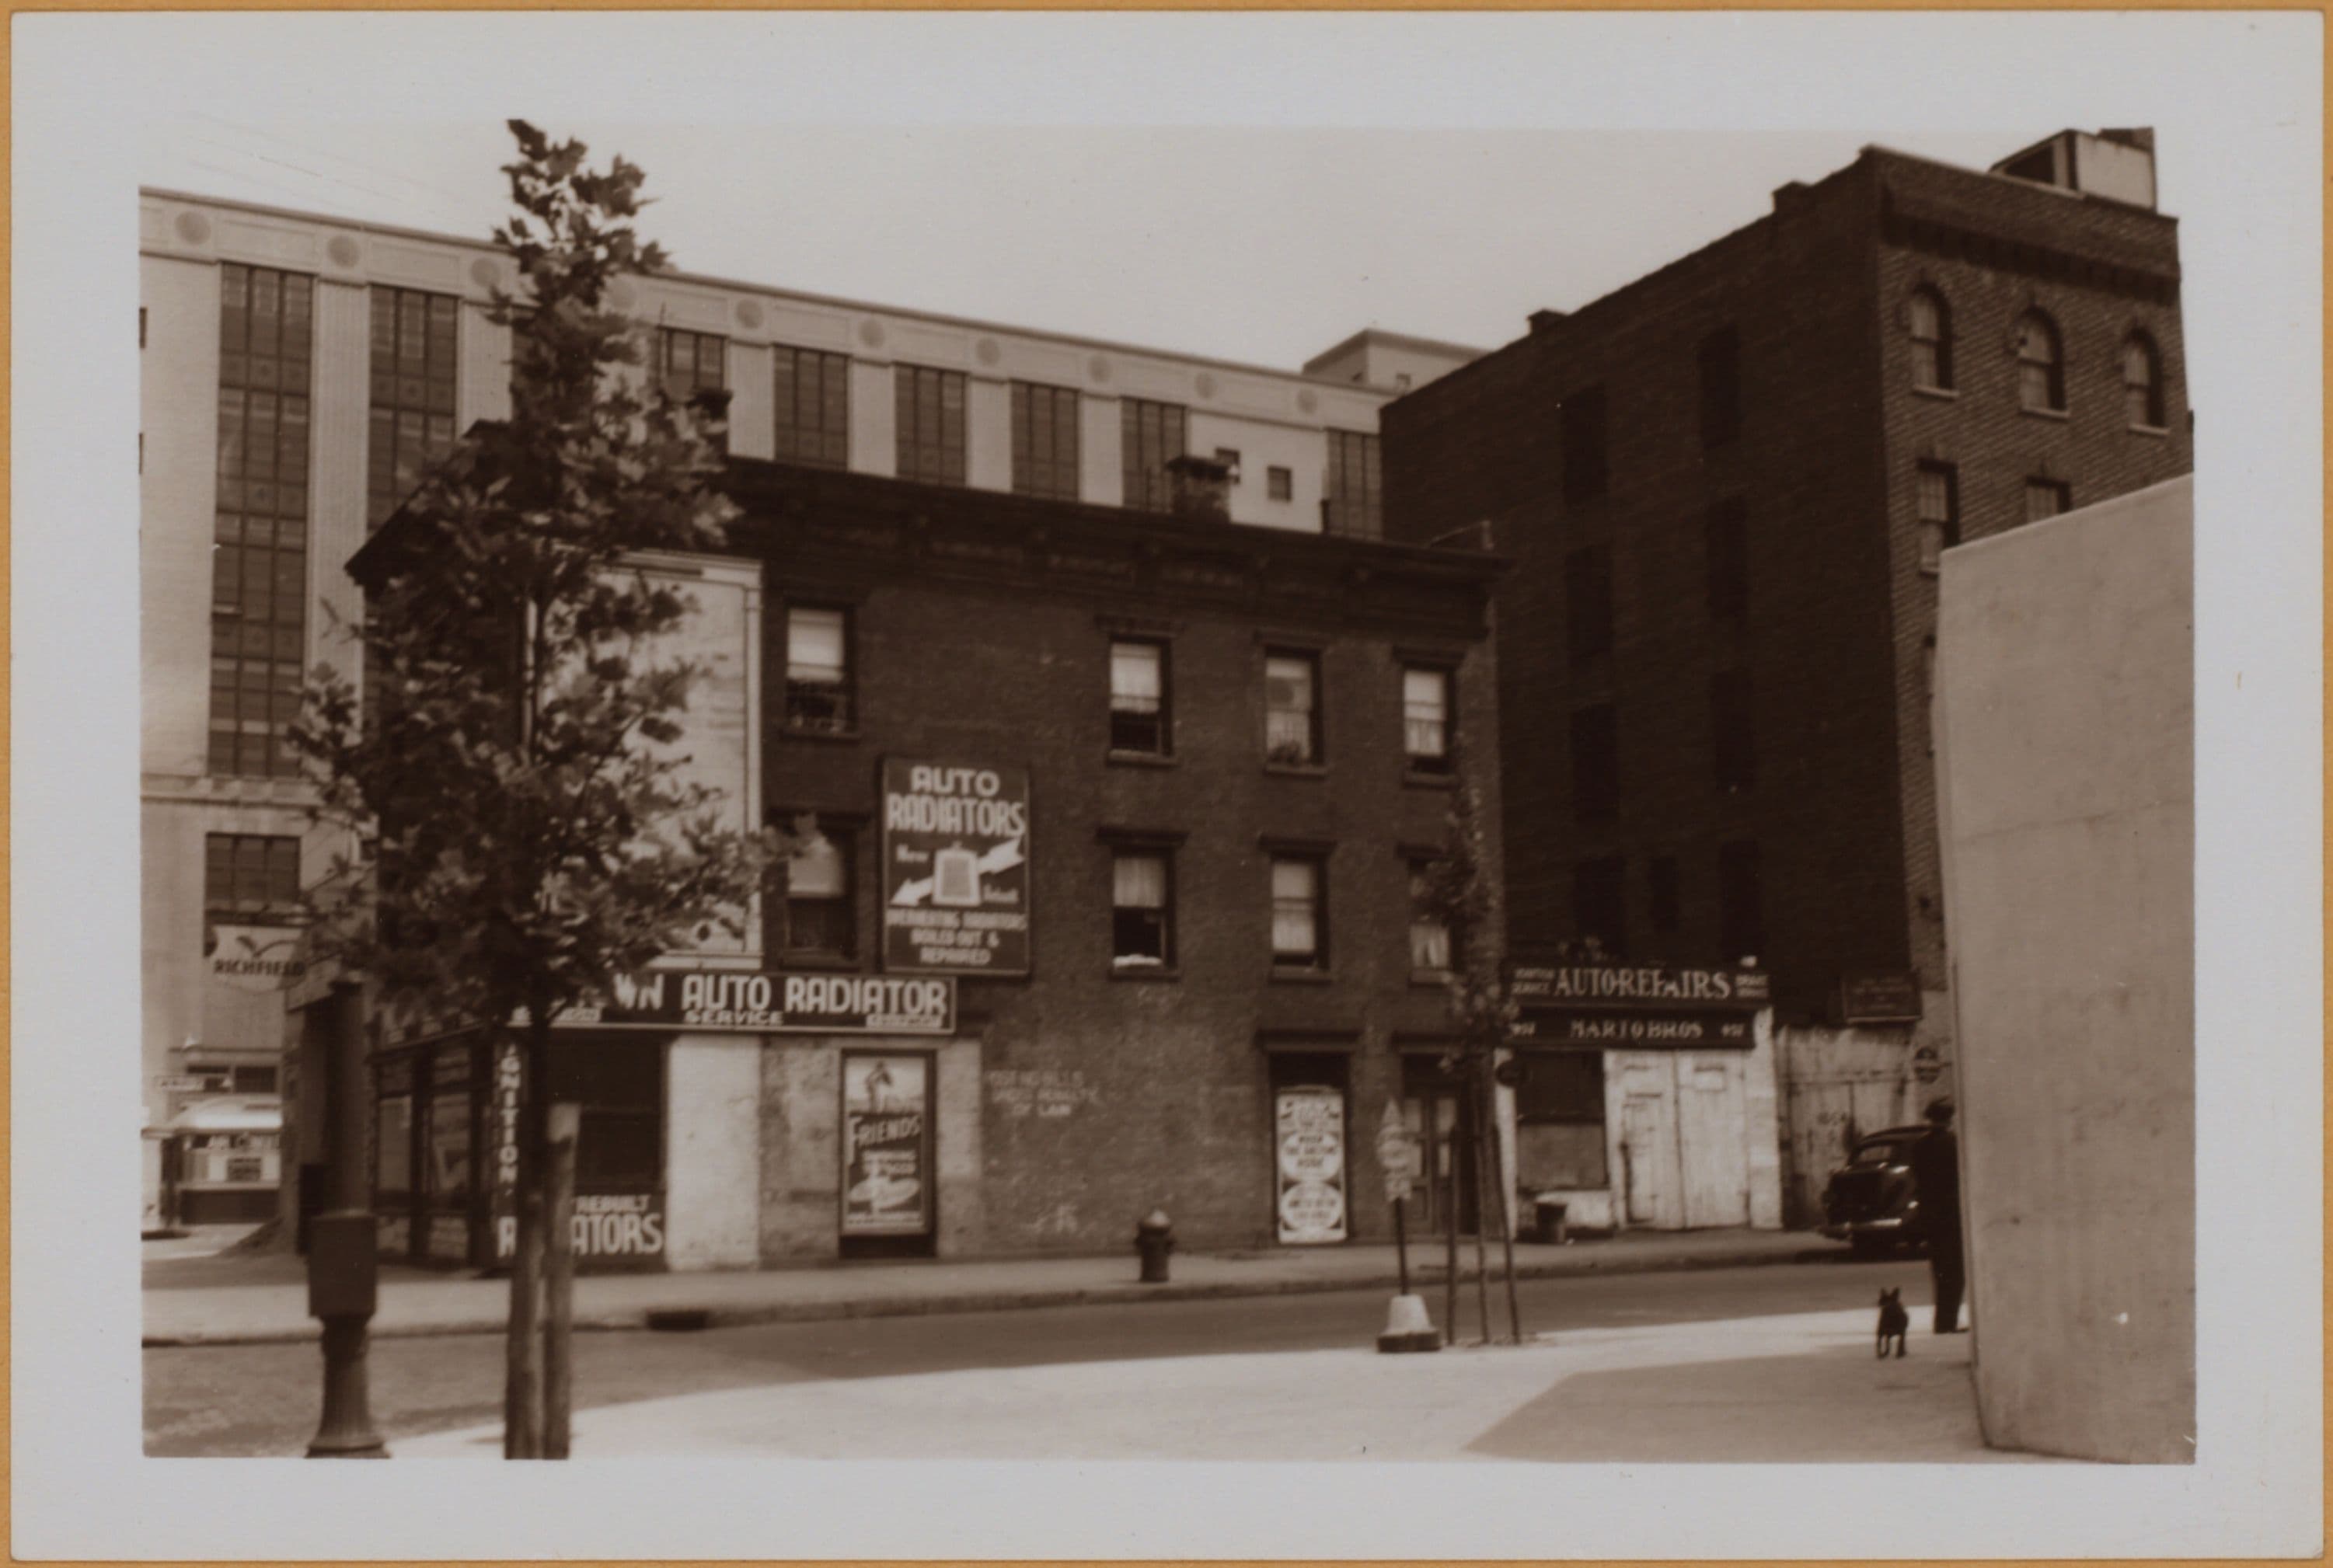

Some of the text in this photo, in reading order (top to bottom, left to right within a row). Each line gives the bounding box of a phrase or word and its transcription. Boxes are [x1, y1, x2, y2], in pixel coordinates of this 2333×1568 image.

[911, 765, 1000, 797] AUTO
[887, 793, 1026, 837] RADIATORS
[214, 959, 306, 976] RICHFIELD
[682, 974, 772, 1012] AUTO
[785, 977, 947, 1016] RADIATOR
[684, 1009, 784, 1026] SERVICE
[1037, 1103, 1072, 1117] LAW
[848, 1114, 922, 1167] FRIENDS
[575, 1193, 652, 1213] REBUILT
